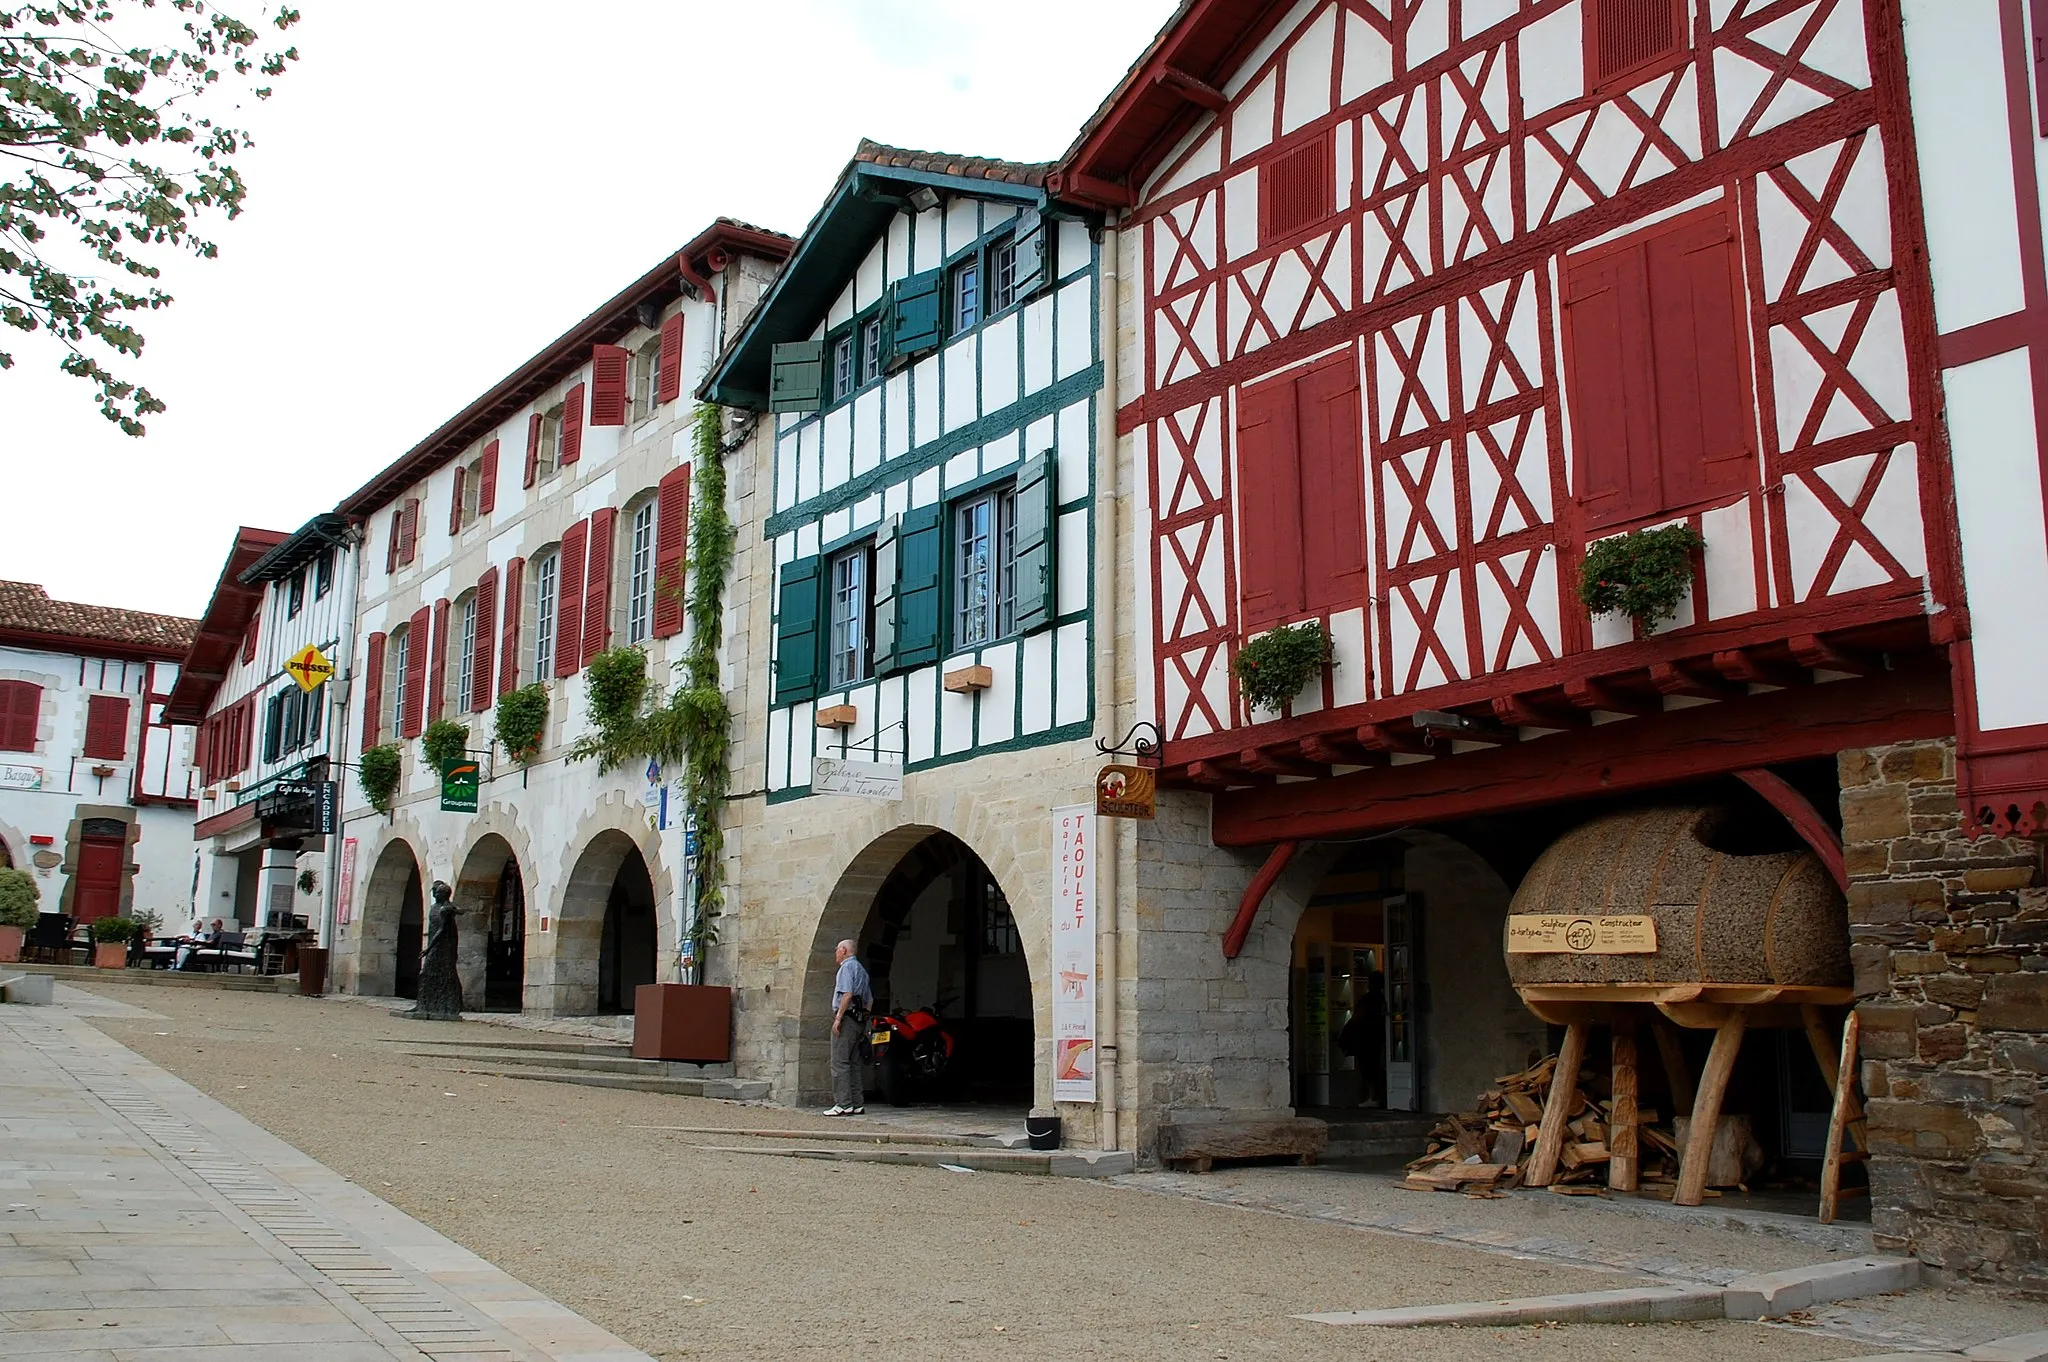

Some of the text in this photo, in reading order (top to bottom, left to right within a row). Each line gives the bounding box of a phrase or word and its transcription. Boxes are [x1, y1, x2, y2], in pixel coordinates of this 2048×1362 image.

[290, 662, 331, 674] PRESSE
[4, 767, 37, 786] Basque
[816, 761, 862, 784] Galerie
[855, 780, 898, 797] Taoulet
[322, 782, 331, 833] ENCADREUR
[442, 798, 477, 808] Groupama
[1101, 801, 1151, 817] SCULPTEUR
[1062, 817, 1070, 897] Galerie
[1074, 815, 1085, 929] TAOULET
[1061, 920, 1071, 931] du
[1541, 918, 1567, 931] Sculpteur
[1600, 918, 1643, 928] Constructeur
